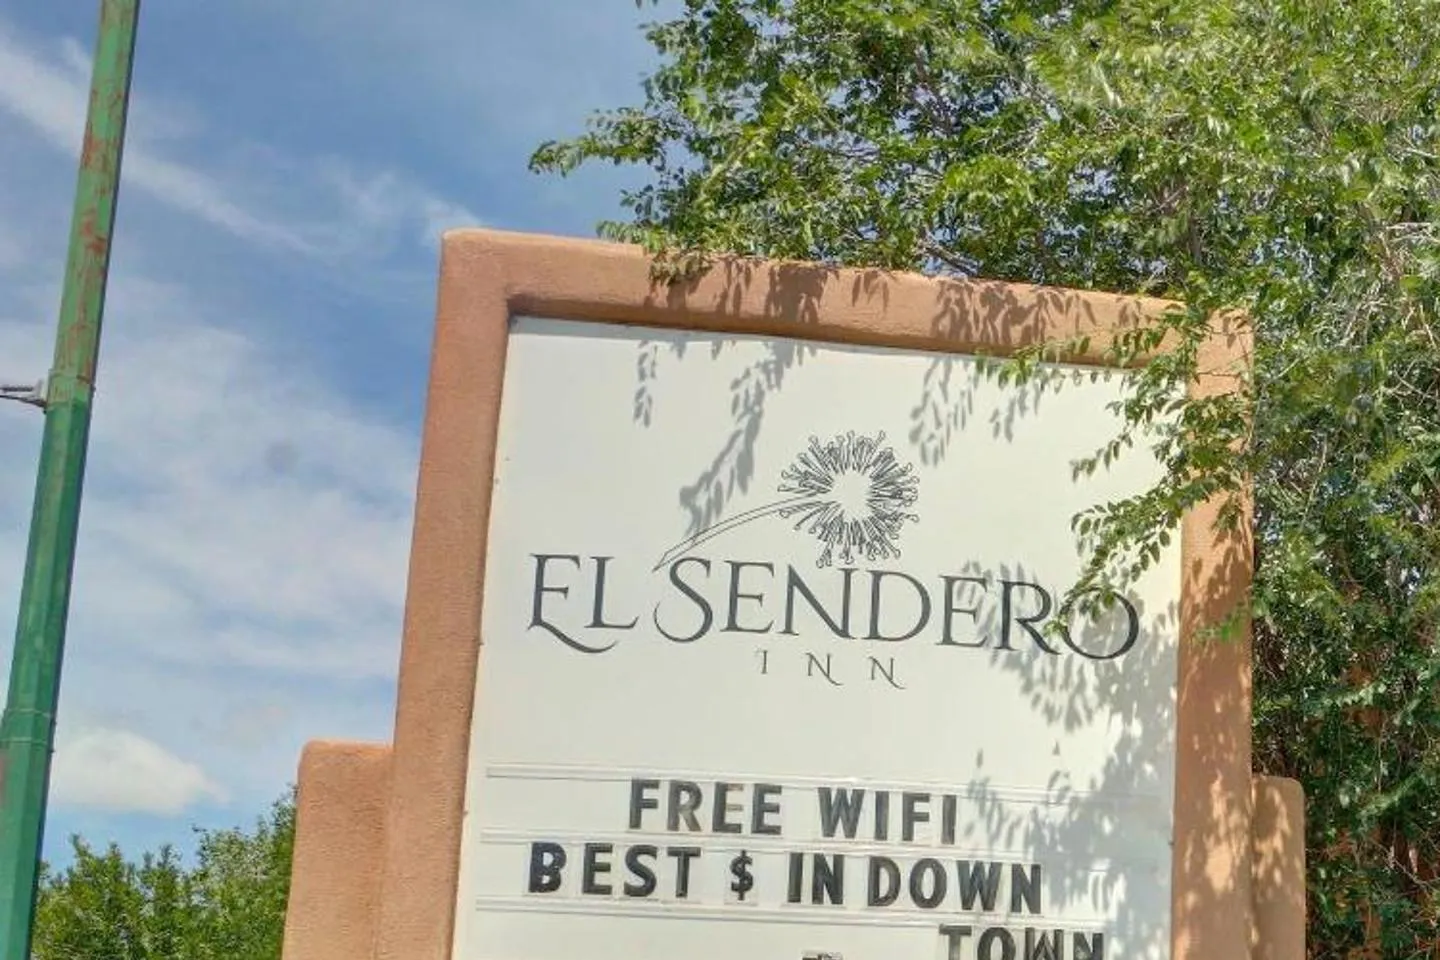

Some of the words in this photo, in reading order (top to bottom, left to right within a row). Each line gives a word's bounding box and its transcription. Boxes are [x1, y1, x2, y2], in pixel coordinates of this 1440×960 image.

[528, 552, 639, 654] EL
[653, 556, 1140, 661] SENDERO
[754, 648, 906, 690] INN
[627, 778, 784, 836] FREE
[818, 786, 958, 846] WIFI
[527, 841, 701, 900] BEST
[866, 855, 1043, 915] DOWN
